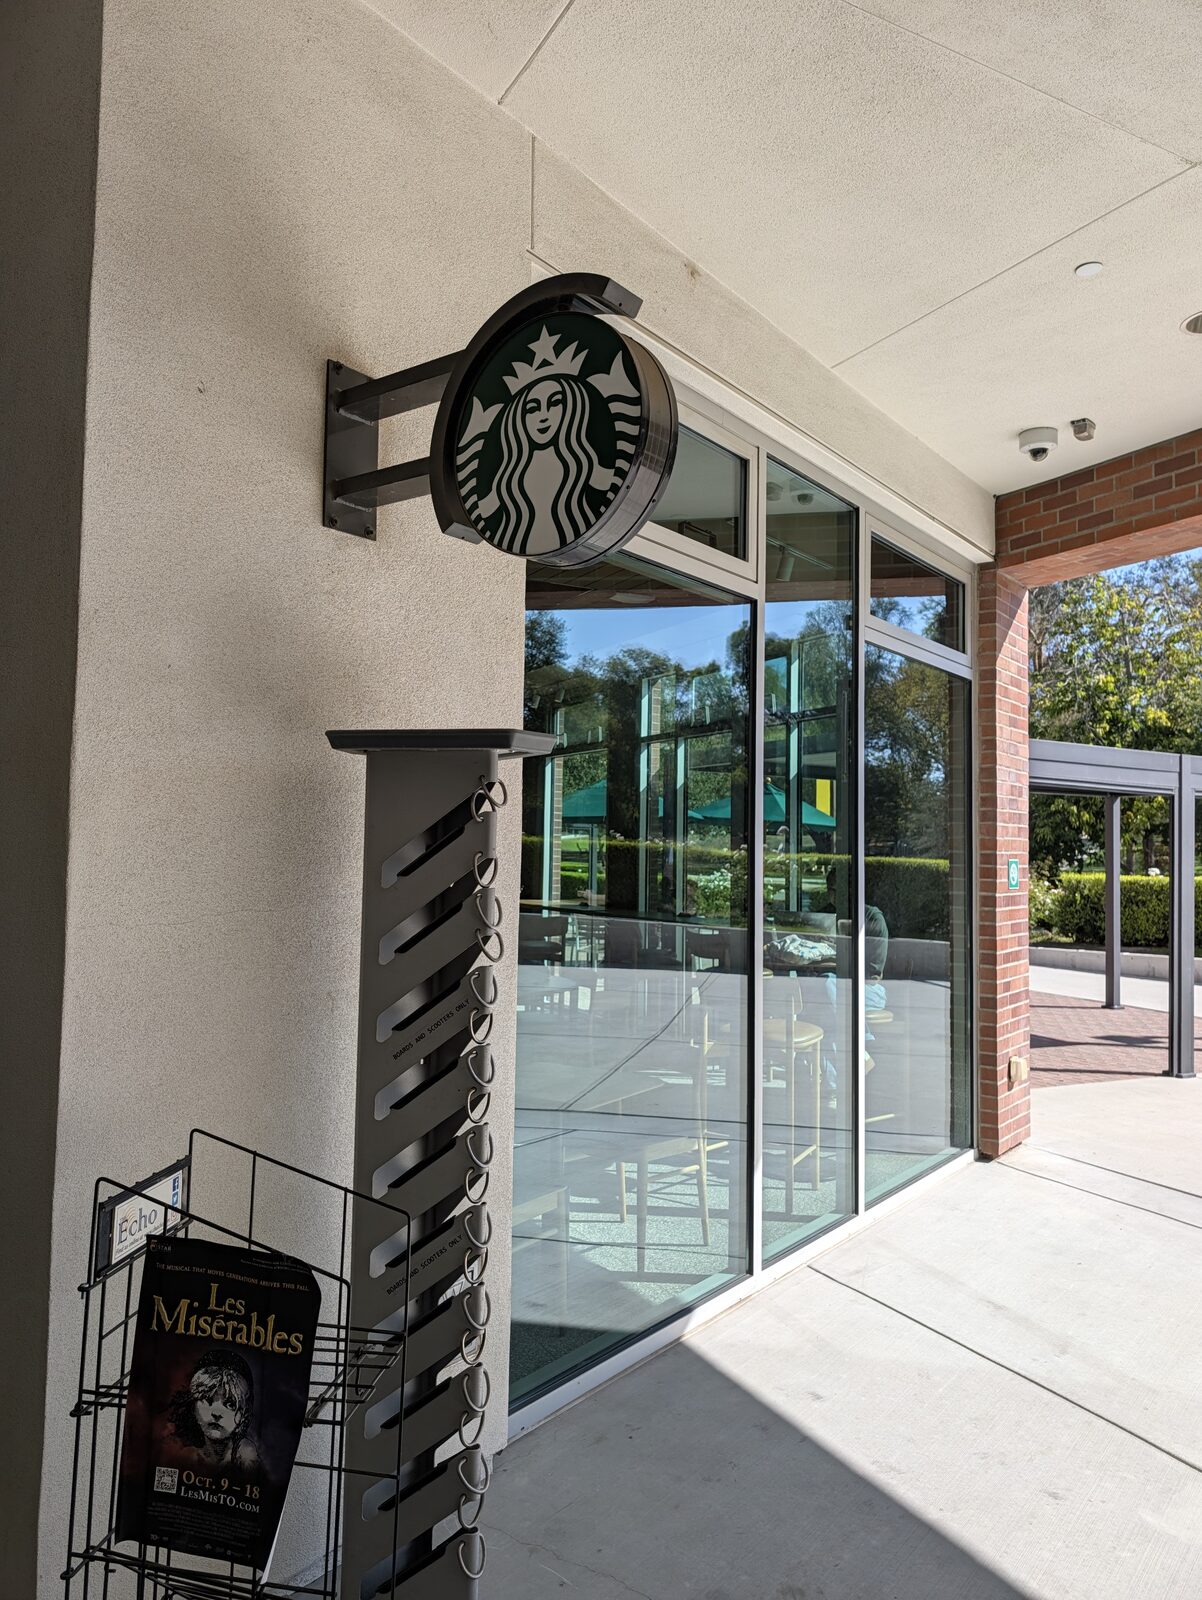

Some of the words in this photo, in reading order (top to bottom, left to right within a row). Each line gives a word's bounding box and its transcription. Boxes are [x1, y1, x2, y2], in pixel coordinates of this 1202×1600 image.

[392, 1042, 414, 1061] BOARDS
[415, 1032, 426, 1044] AND
[427, 1011, 455, 1034] SCOOTERS
[455, 999, 470, 1013] ONLY
[118, 1207, 158, 1244] Echo
[156, 1262, 165, 1270] THE
[166, 1264, 191, 1273] MUSICAL
[192, 1266, 206, 1275] THAT
[207, 1269, 225, 1278] MOVES
[225, 1272, 258, 1284] GENERATIONS
[259, 1280, 281, 1289] ARRIVES
[282, 1282, 296, 1290] THIS
[386, 1277, 408, 1296] BOARDS
[409, 1267, 420, 1279] AND
[420, 1246, 448, 1269] SCOOTERS
[448, 1234, 463, 1249] ONLY
[207, 1283, 245, 1315] Les
[150, 1295, 304, 1355] Misérables
[220, 1478, 229, 1491] 9
[245, 1484, 260, 1500] 18
